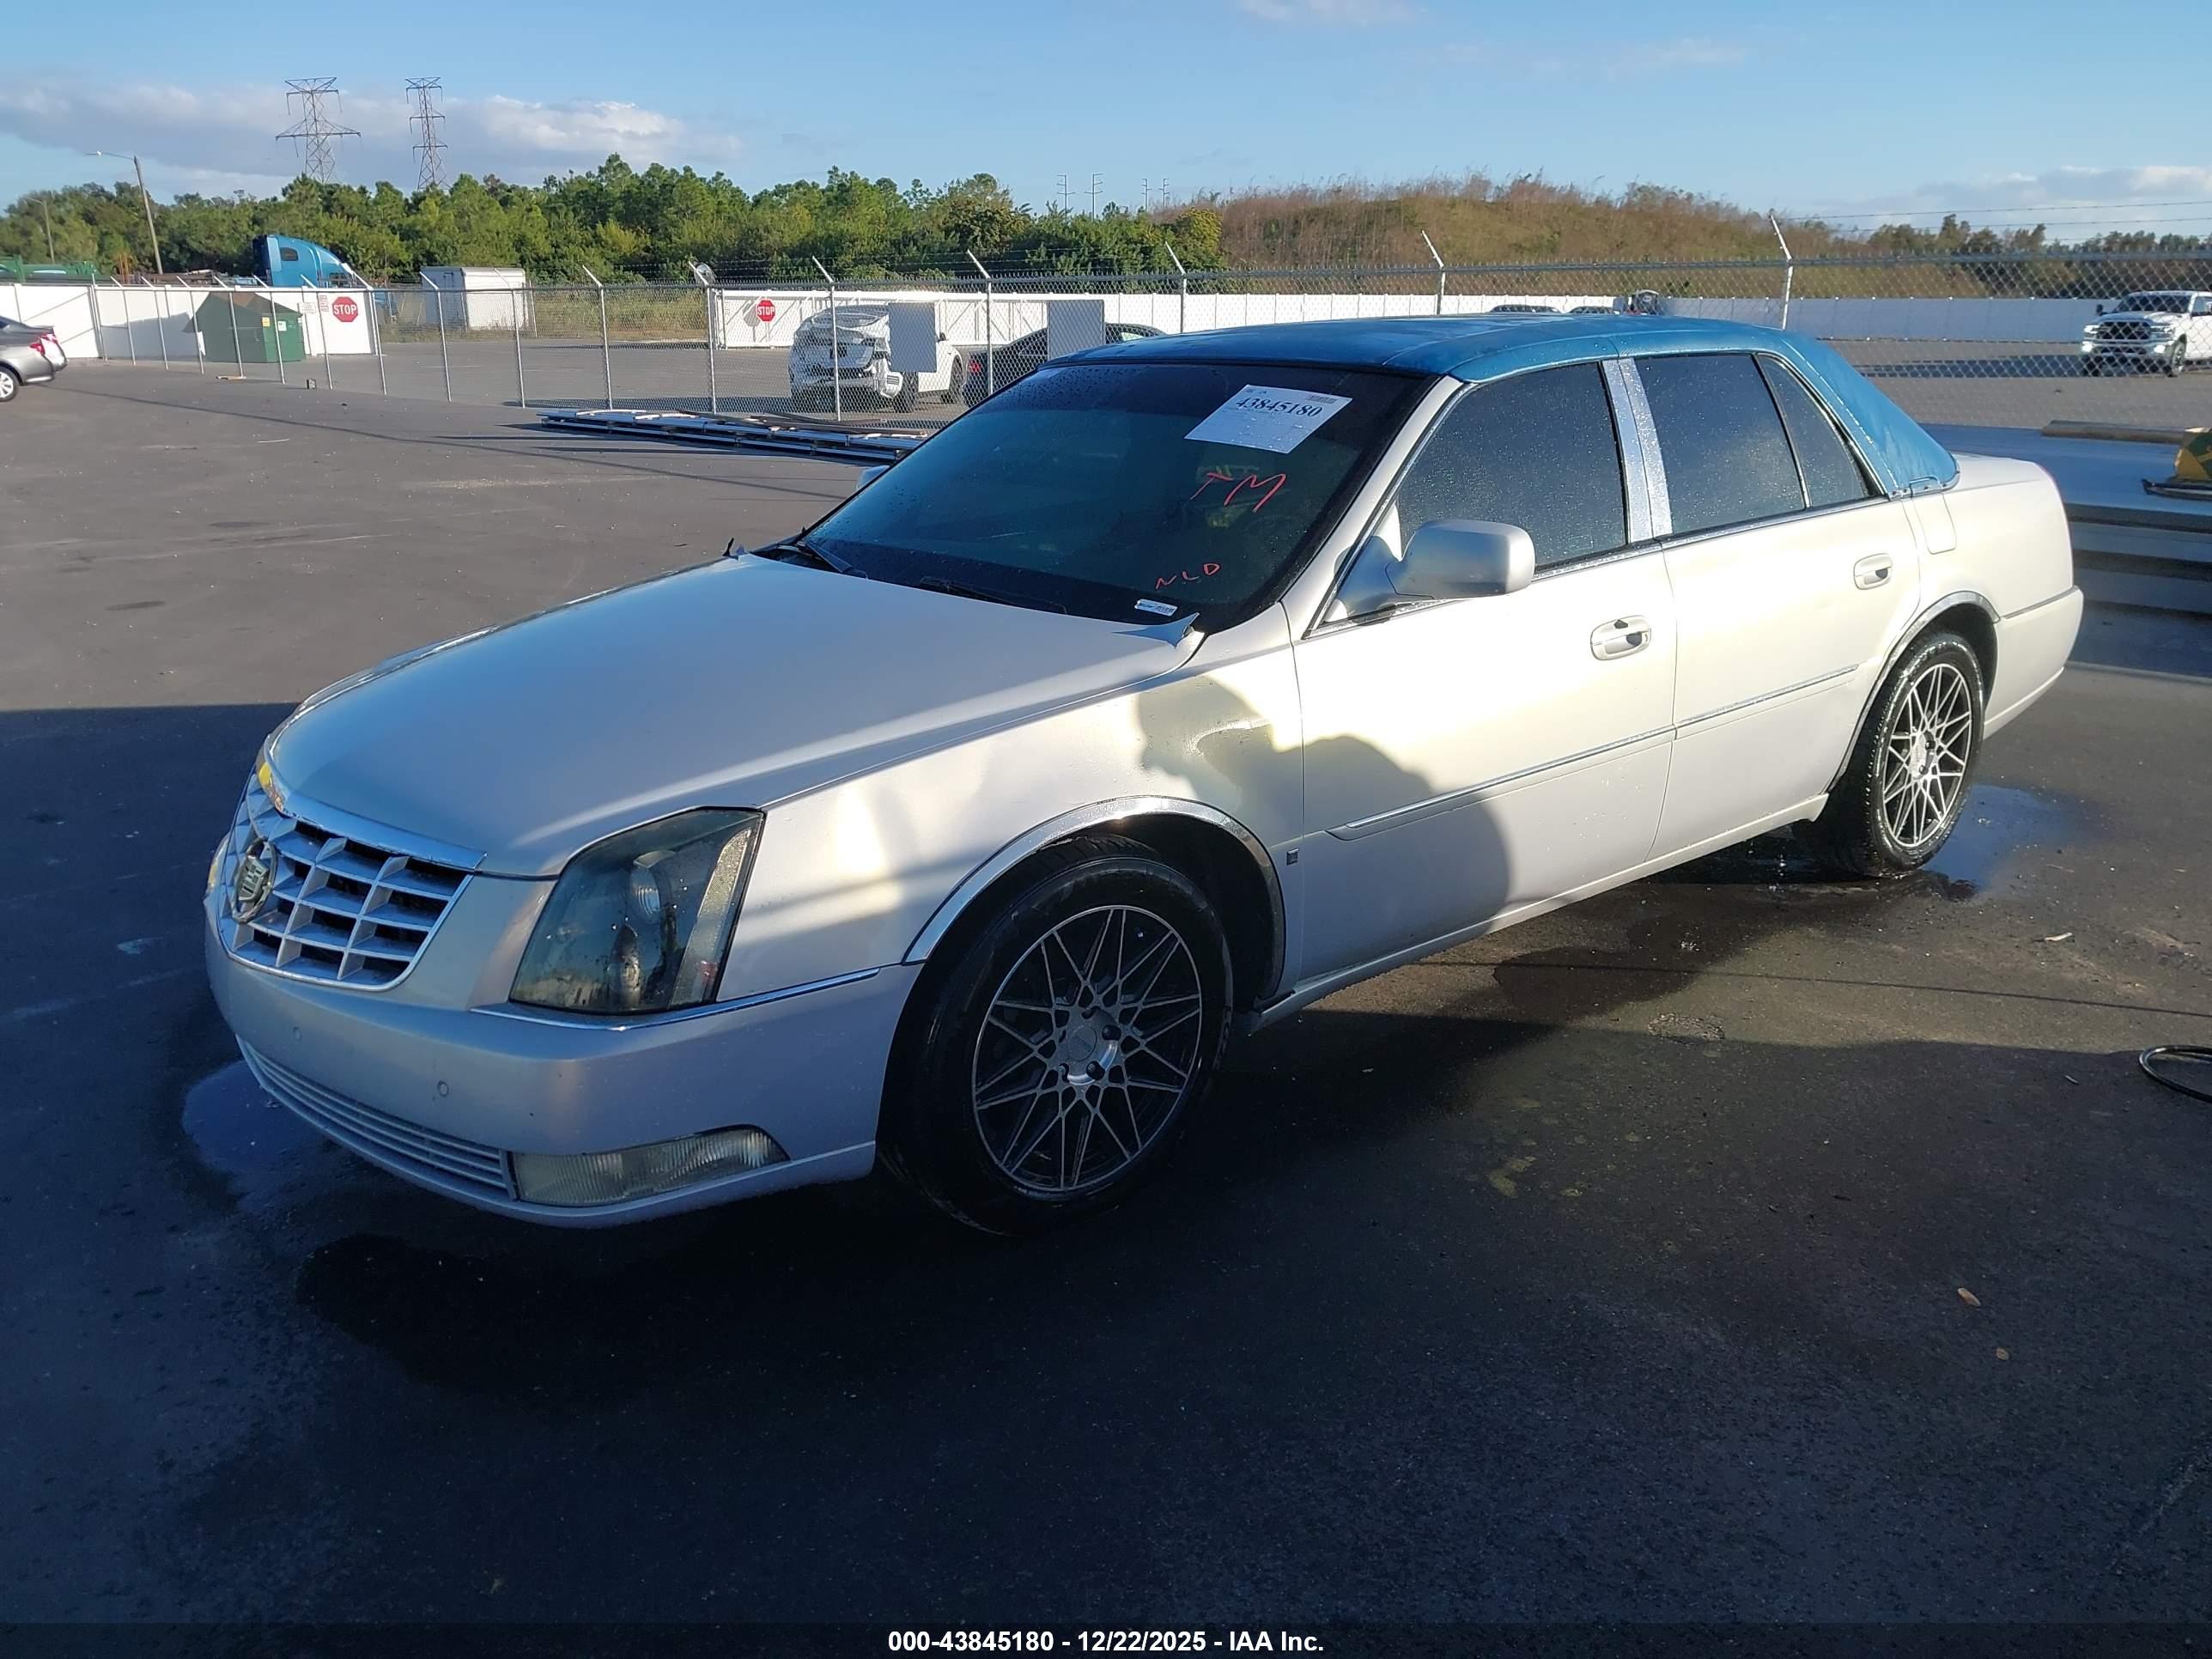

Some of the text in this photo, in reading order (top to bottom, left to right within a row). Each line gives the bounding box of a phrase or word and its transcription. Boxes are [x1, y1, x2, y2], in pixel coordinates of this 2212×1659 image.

[333, 304, 356, 315] STOP
[757, 306, 775, 316] STOP
[1236, 397, 1323, 417] 43845180
